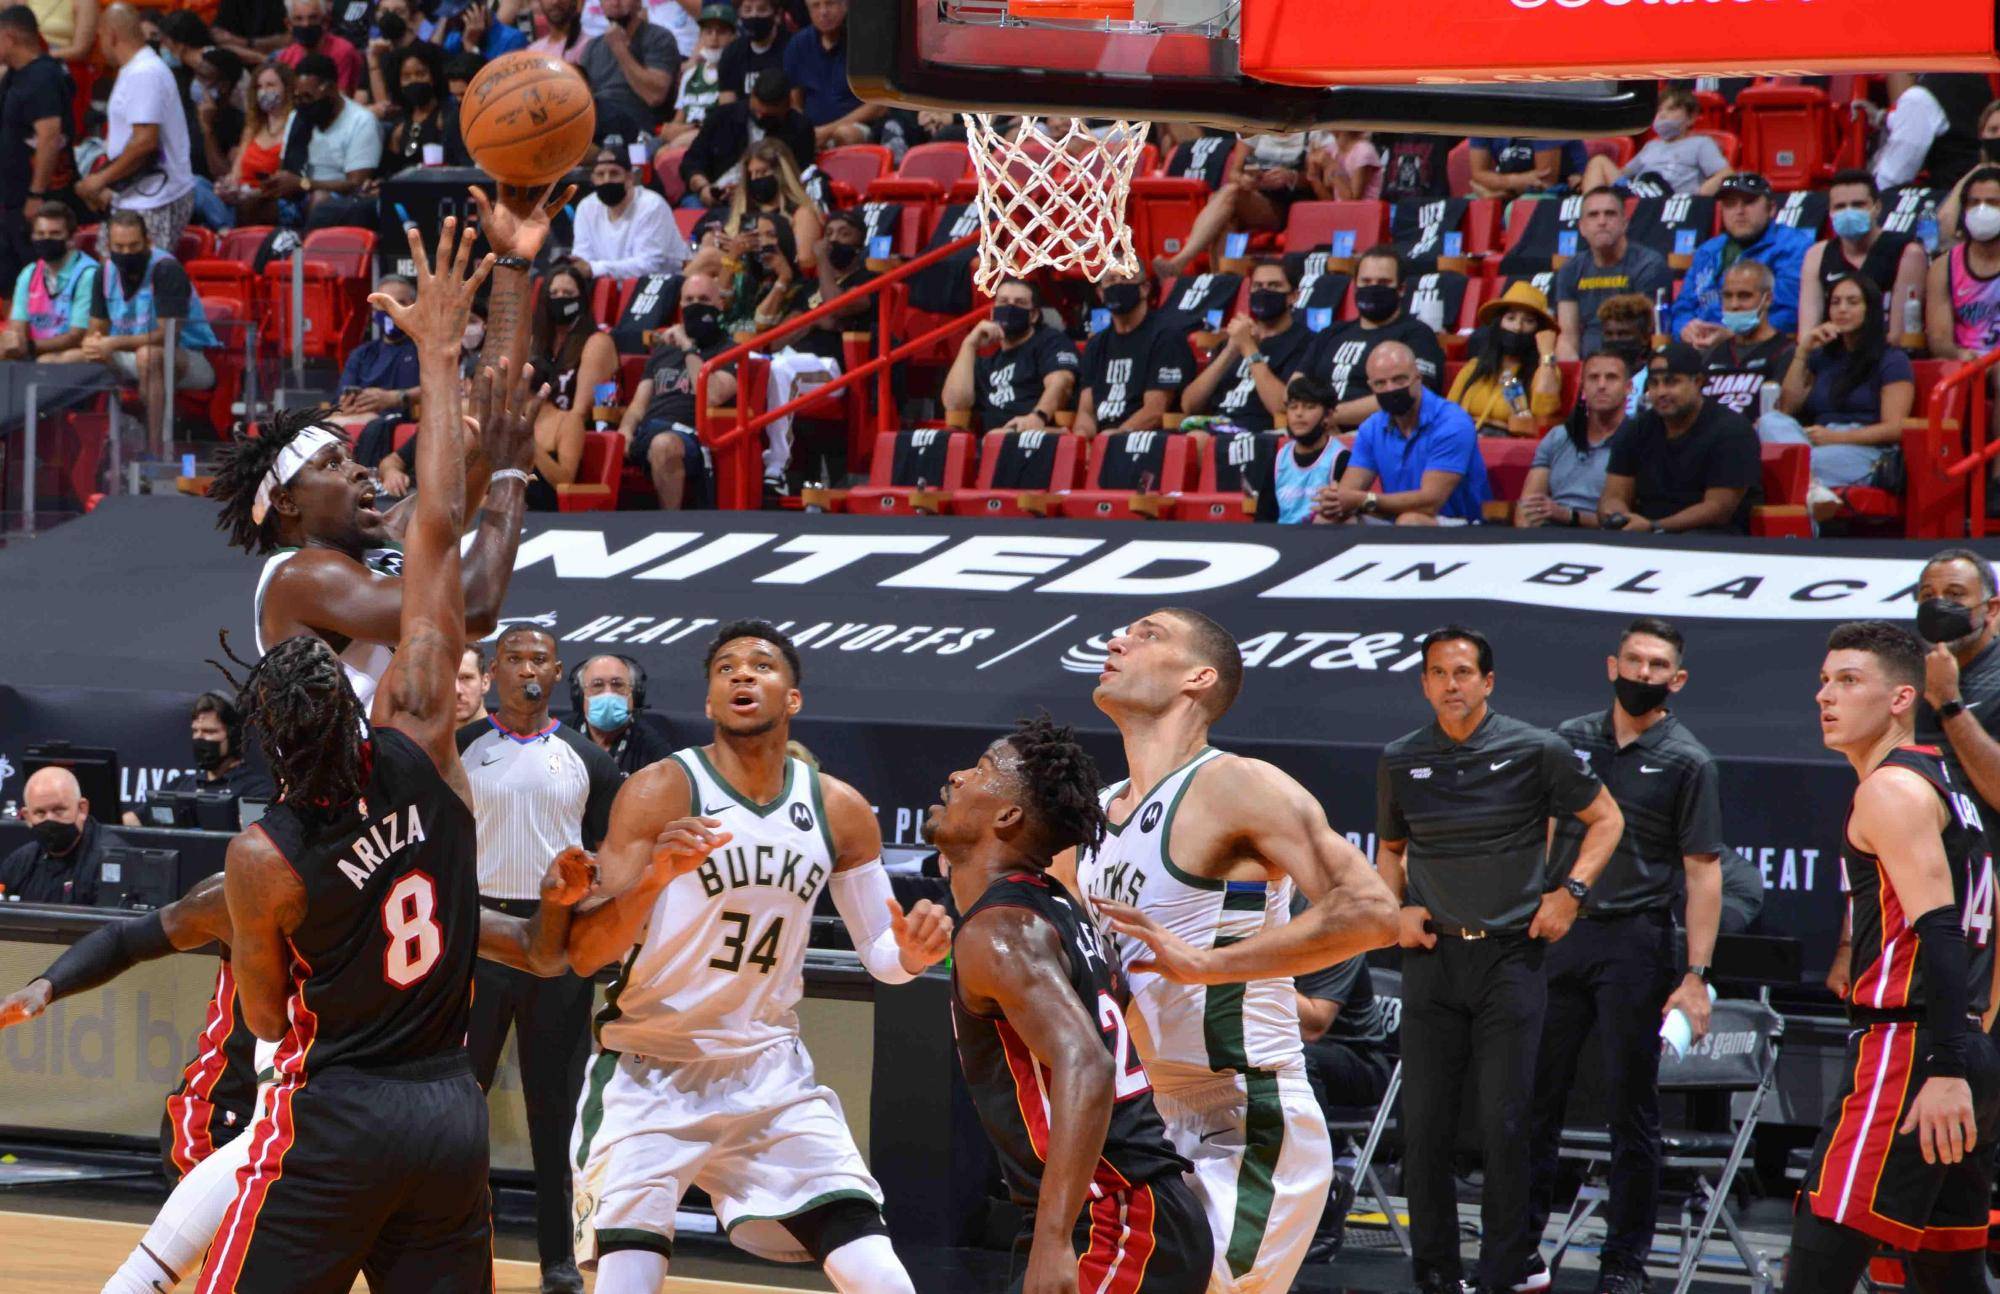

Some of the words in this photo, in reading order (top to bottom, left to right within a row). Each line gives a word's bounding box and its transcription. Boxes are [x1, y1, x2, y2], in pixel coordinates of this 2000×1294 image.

[461, 529, 1281, 595] NITED
[1333, 562, 1470, 582] IN
[560, 615, 719, 644] HEAT
[768, 620, 995, 655] LAYOFFS
[337, 805, 425, 890] ARIZA
[697, 845, 825, 904] BUCKS
[381, 868, 444, 991] 8
[709, 911, 784, 974] 34
[1711, 1031, 1758, 1060] game
